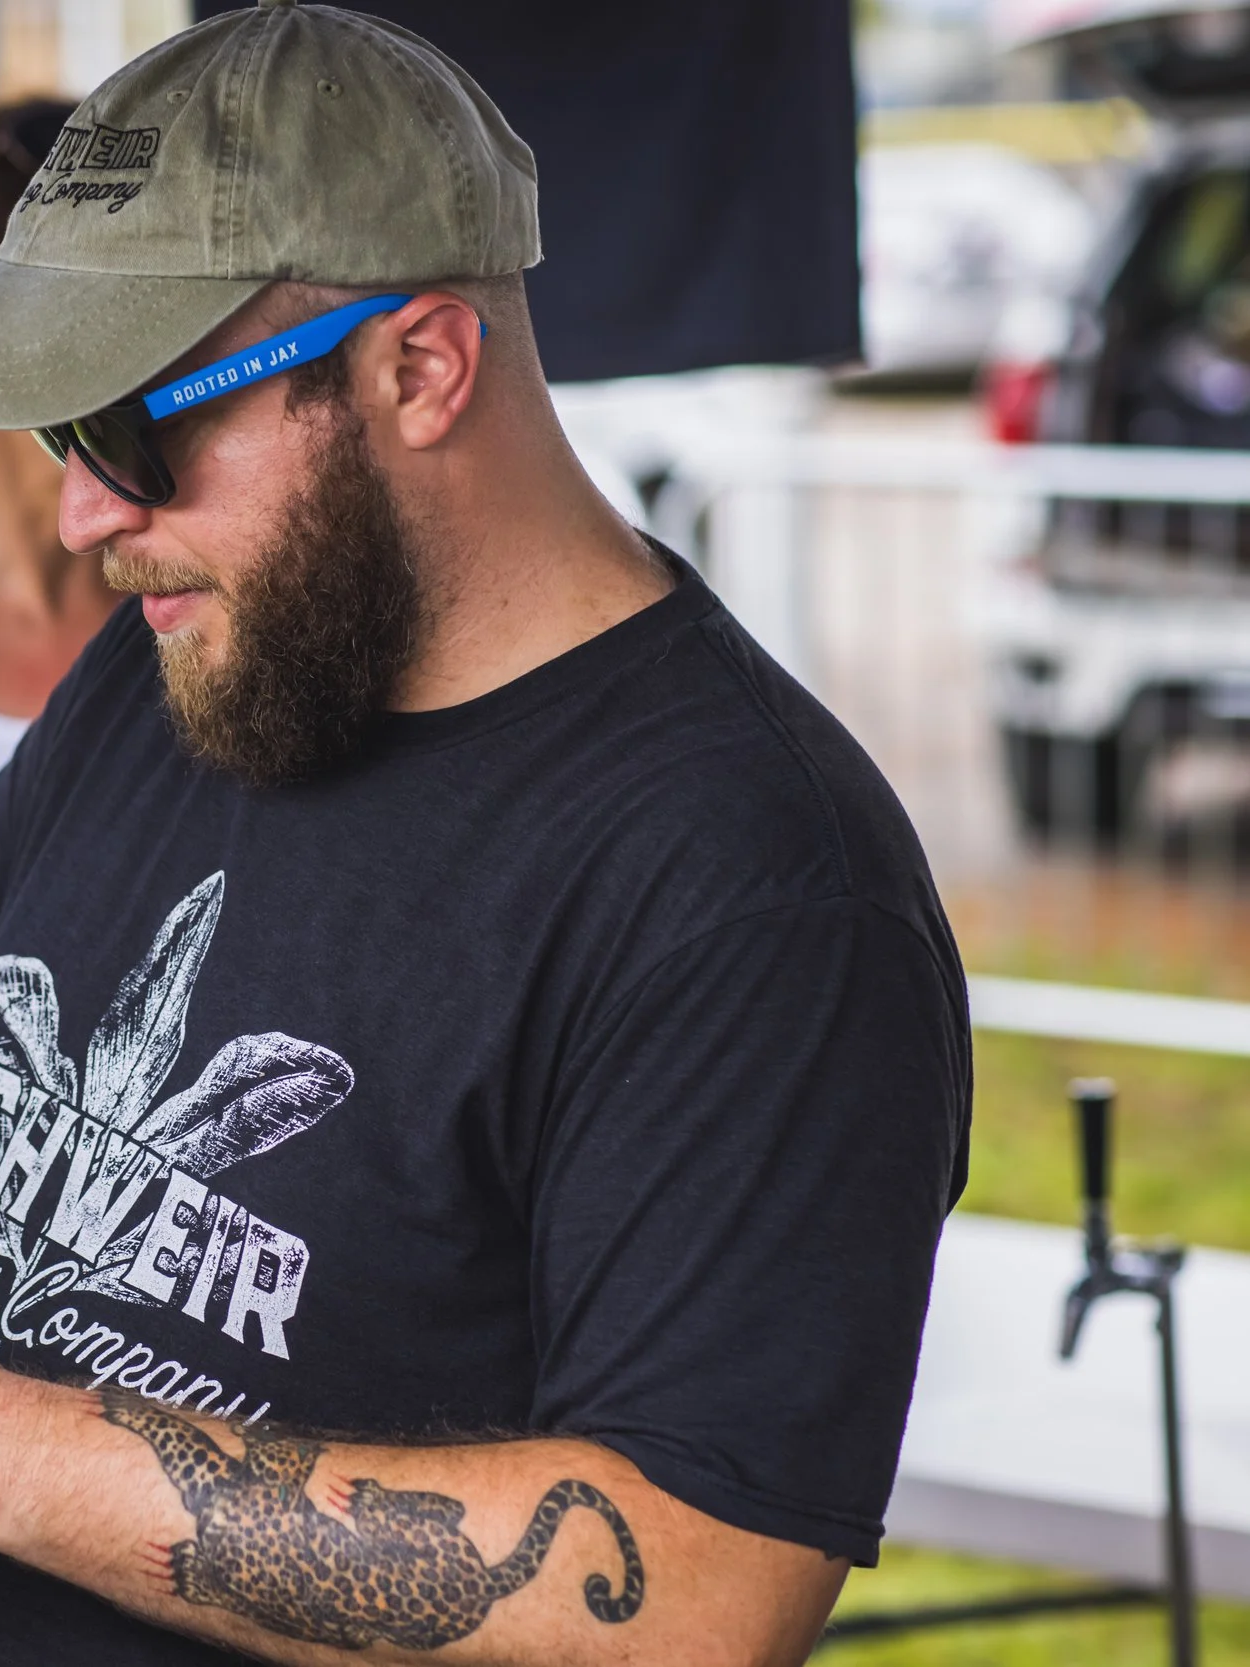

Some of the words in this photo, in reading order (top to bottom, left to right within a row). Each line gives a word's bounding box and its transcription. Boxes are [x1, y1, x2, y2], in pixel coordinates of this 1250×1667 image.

[41, 172, 143, 214] Company
[172, 367, 239, 405] ROOTED
[243, 357, 263, 377] IN
[269, 341, 299, 367] JAX
